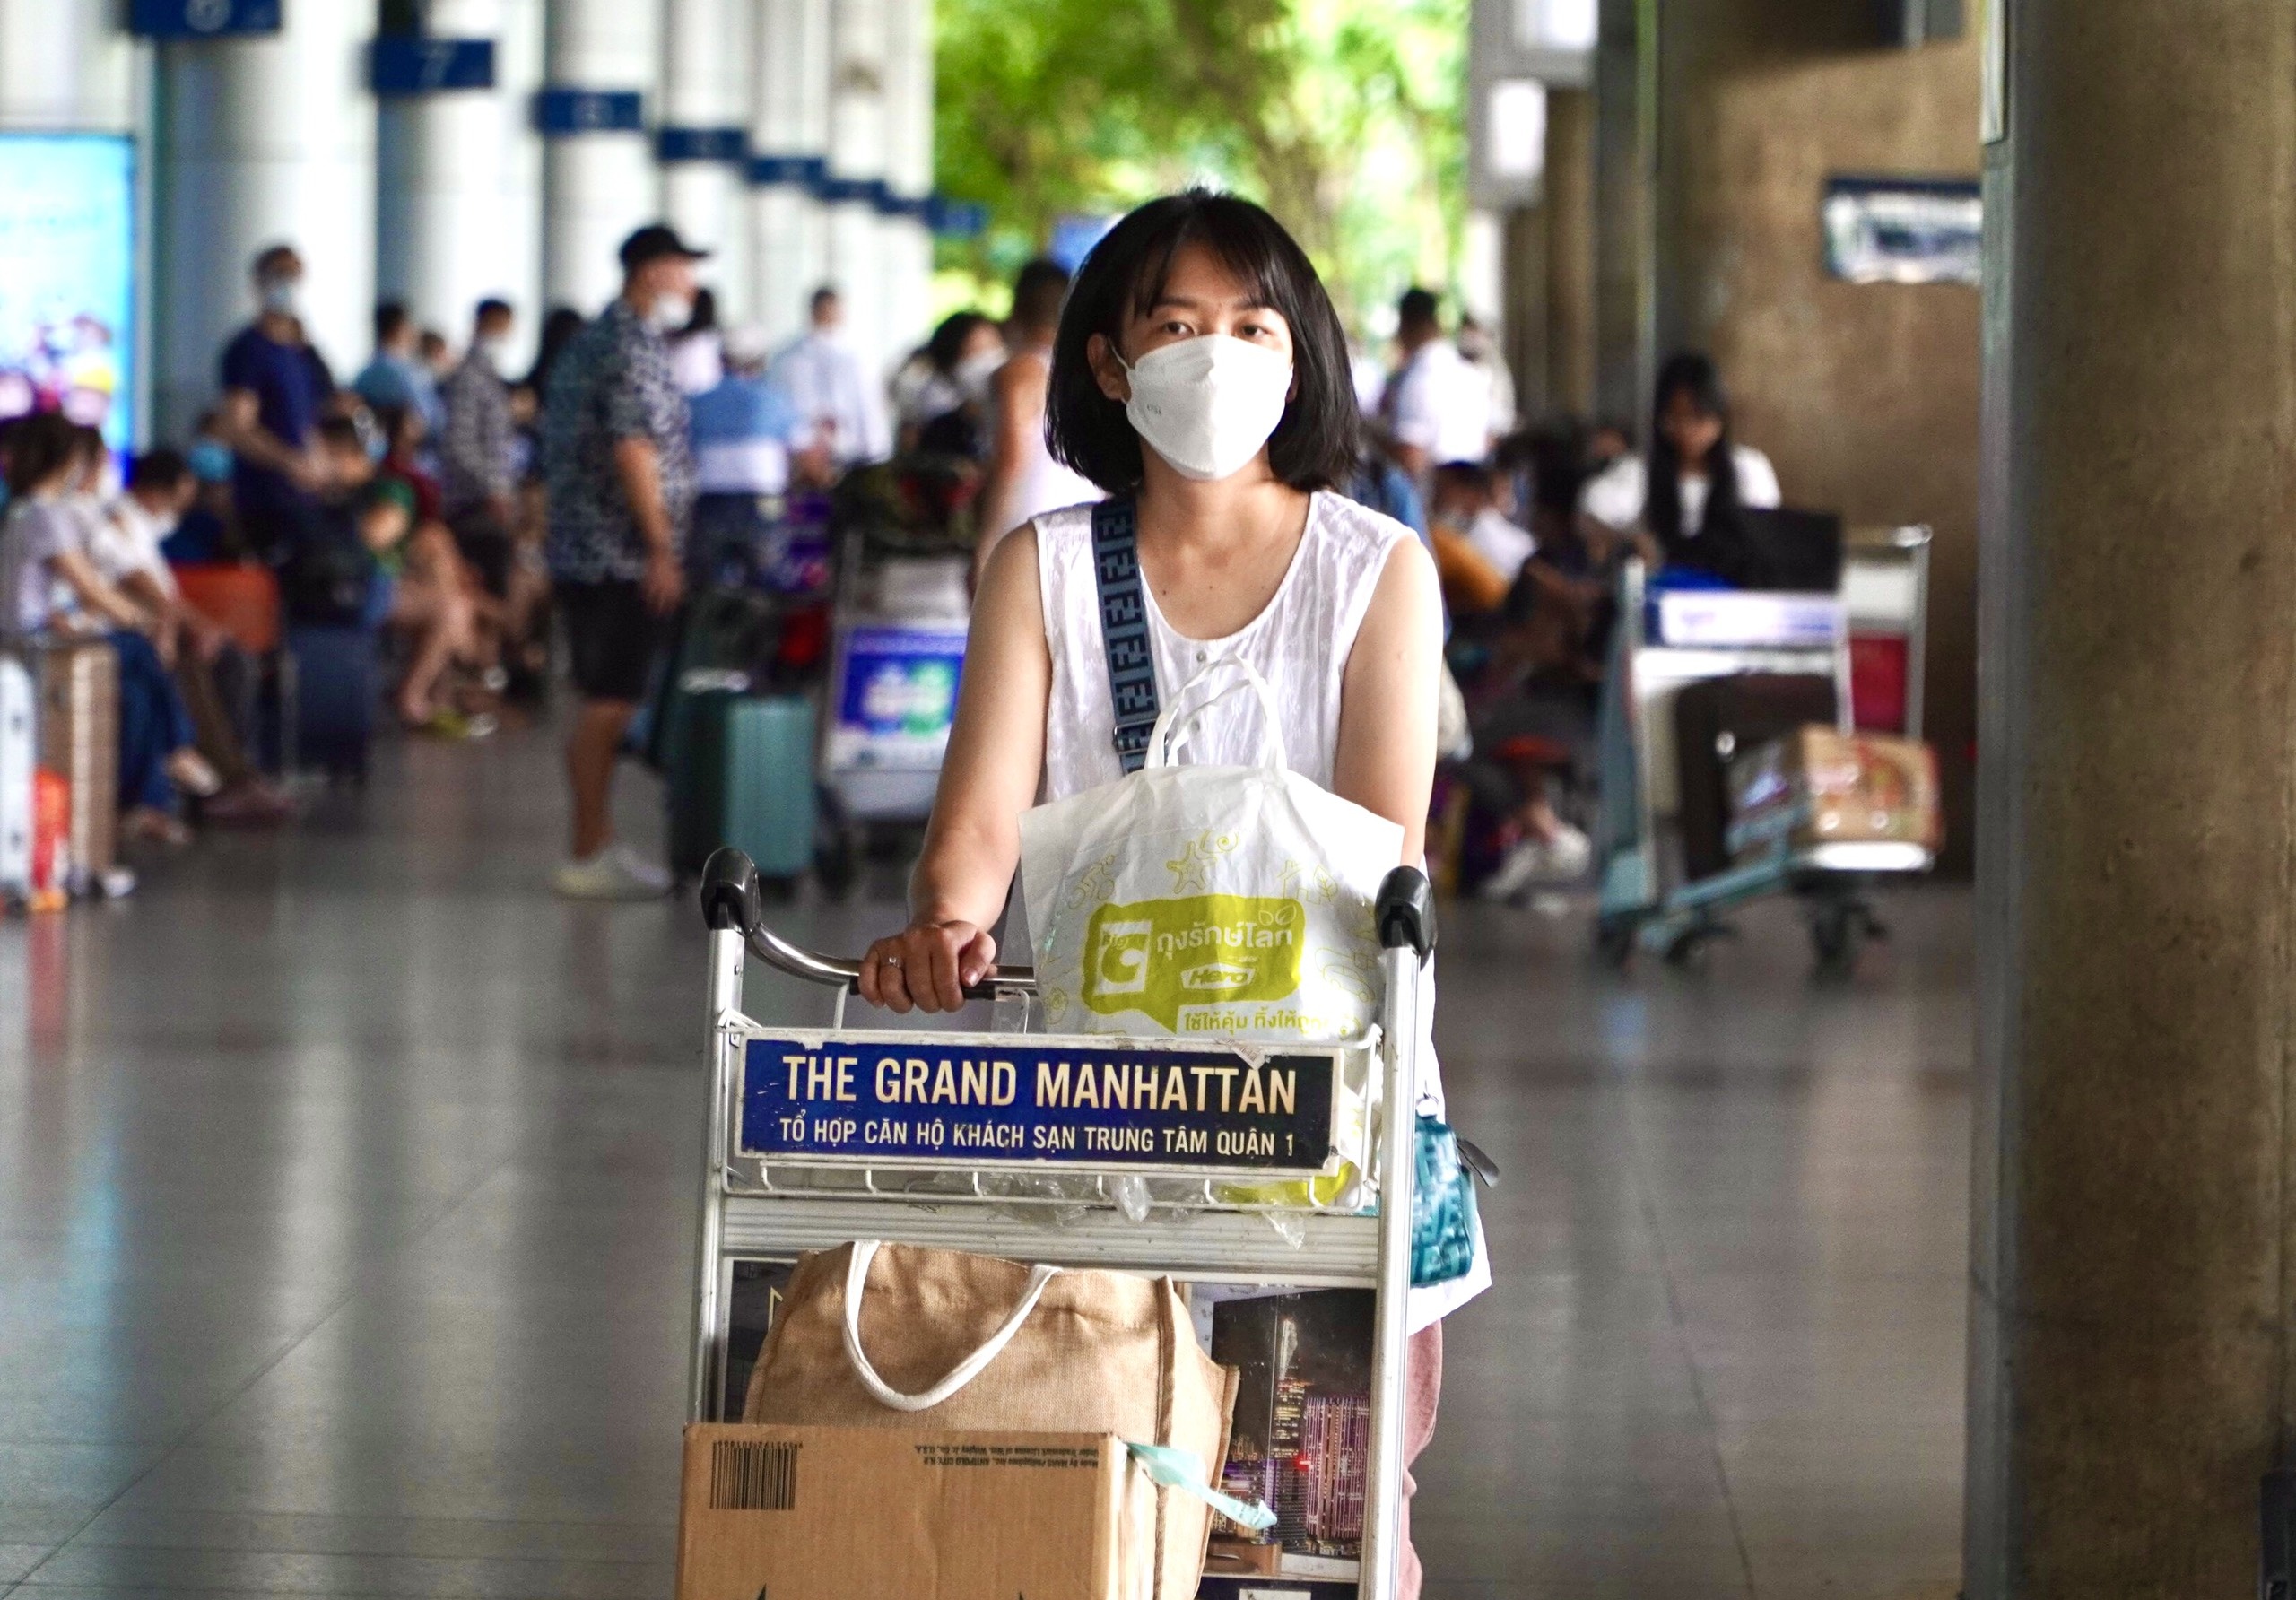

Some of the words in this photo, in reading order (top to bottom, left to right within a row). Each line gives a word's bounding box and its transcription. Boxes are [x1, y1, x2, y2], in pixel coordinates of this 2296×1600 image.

[783, 1056, 858, 1101] THE
[875, 1058, 1017, 1106] GRAND
[1036, 1062, 1296, 1115] MANHATTAN
[780, 1109, 806, 1142] TỔ
[865, 1118, 908, 1144] CĂN
[916, 1118, 944, 1151] HỘ
[953, 1121, 1024, 1148] KHÁCH
[1033, 1126, 1075, 1153] SẠN
[1084, 1126, 1154, 1152] TRUNG
[1163, 1126, 1208, 1154] TÂM
[1285, 1134, 1294, 1157] 1
